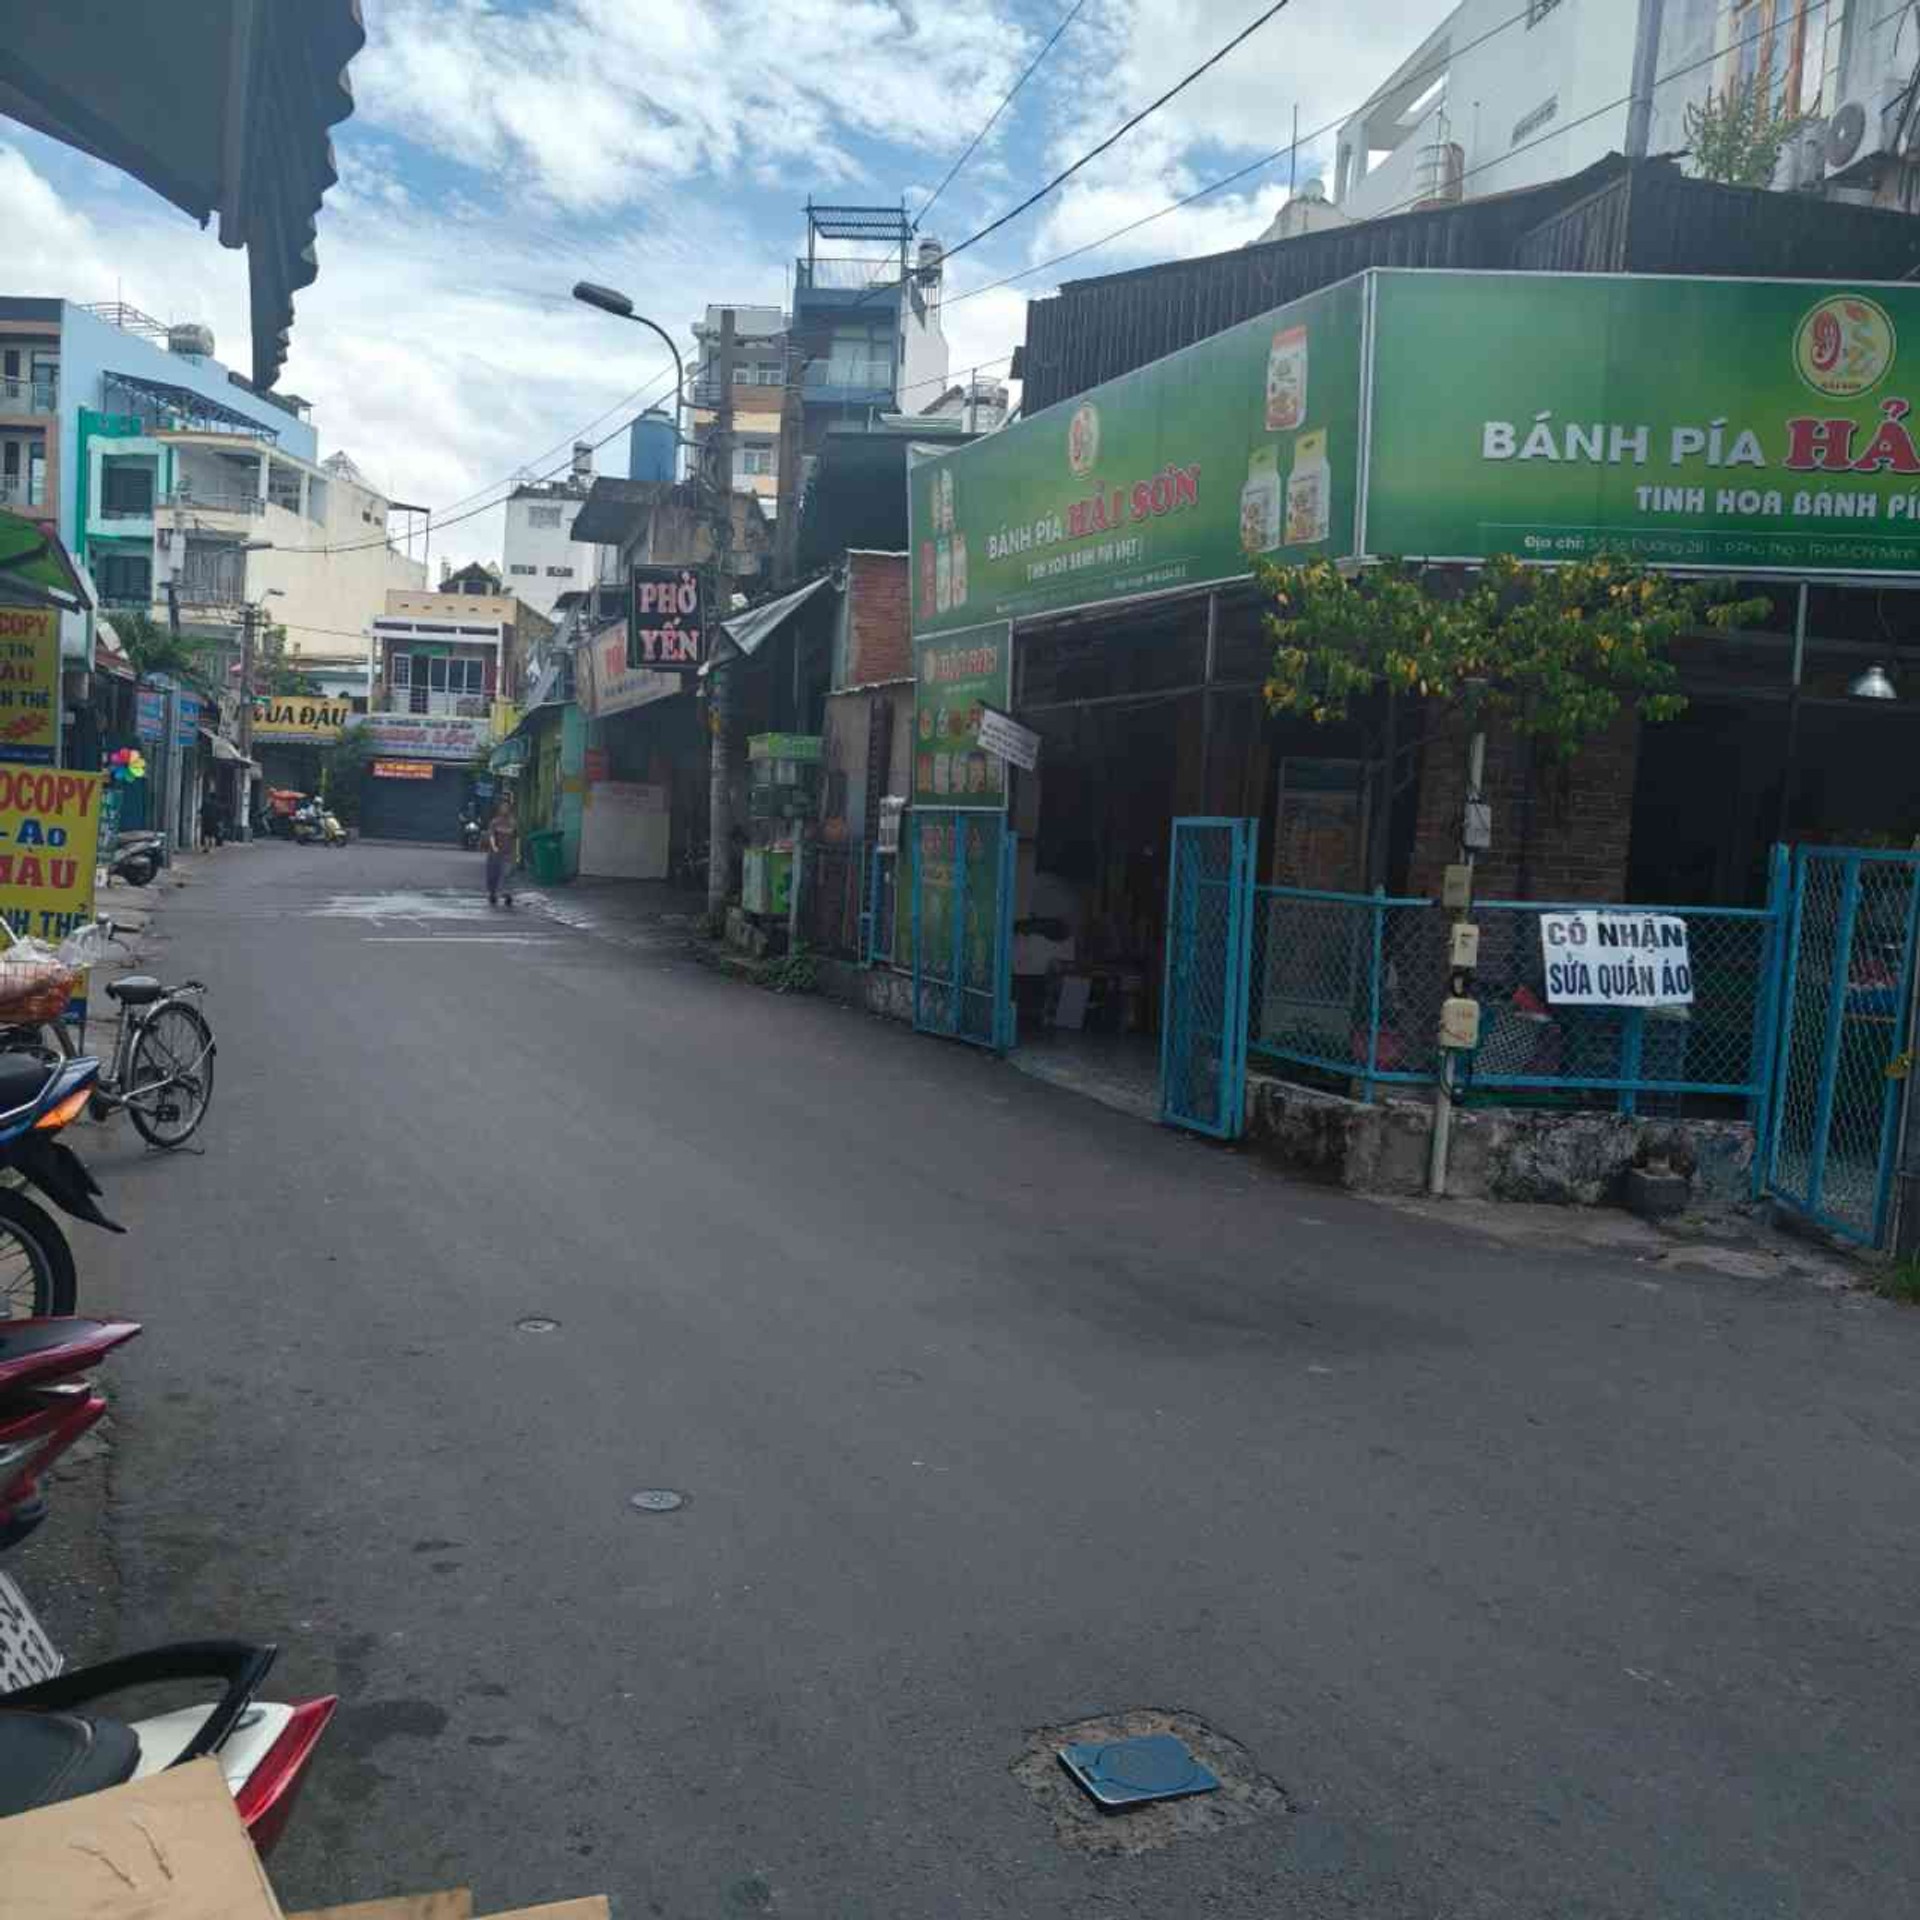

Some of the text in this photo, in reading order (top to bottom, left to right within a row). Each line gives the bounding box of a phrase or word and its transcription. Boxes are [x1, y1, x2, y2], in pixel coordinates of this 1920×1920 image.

[1482, 410, 1650, 465] BÁNH
[1671, 416, 1766, 467] PÍA
[1635, 483, 1920, 519] TINH HOA BÁNH PÍ
[987, 522, 1032, 560] BÁNH
[638, 571, 698, 614] PHỞ
[640, 616, 700, 662] YẾN
[1598, 918, 1684, 953] NHẬN
[1549, 951, 1593, 995] SỬA
